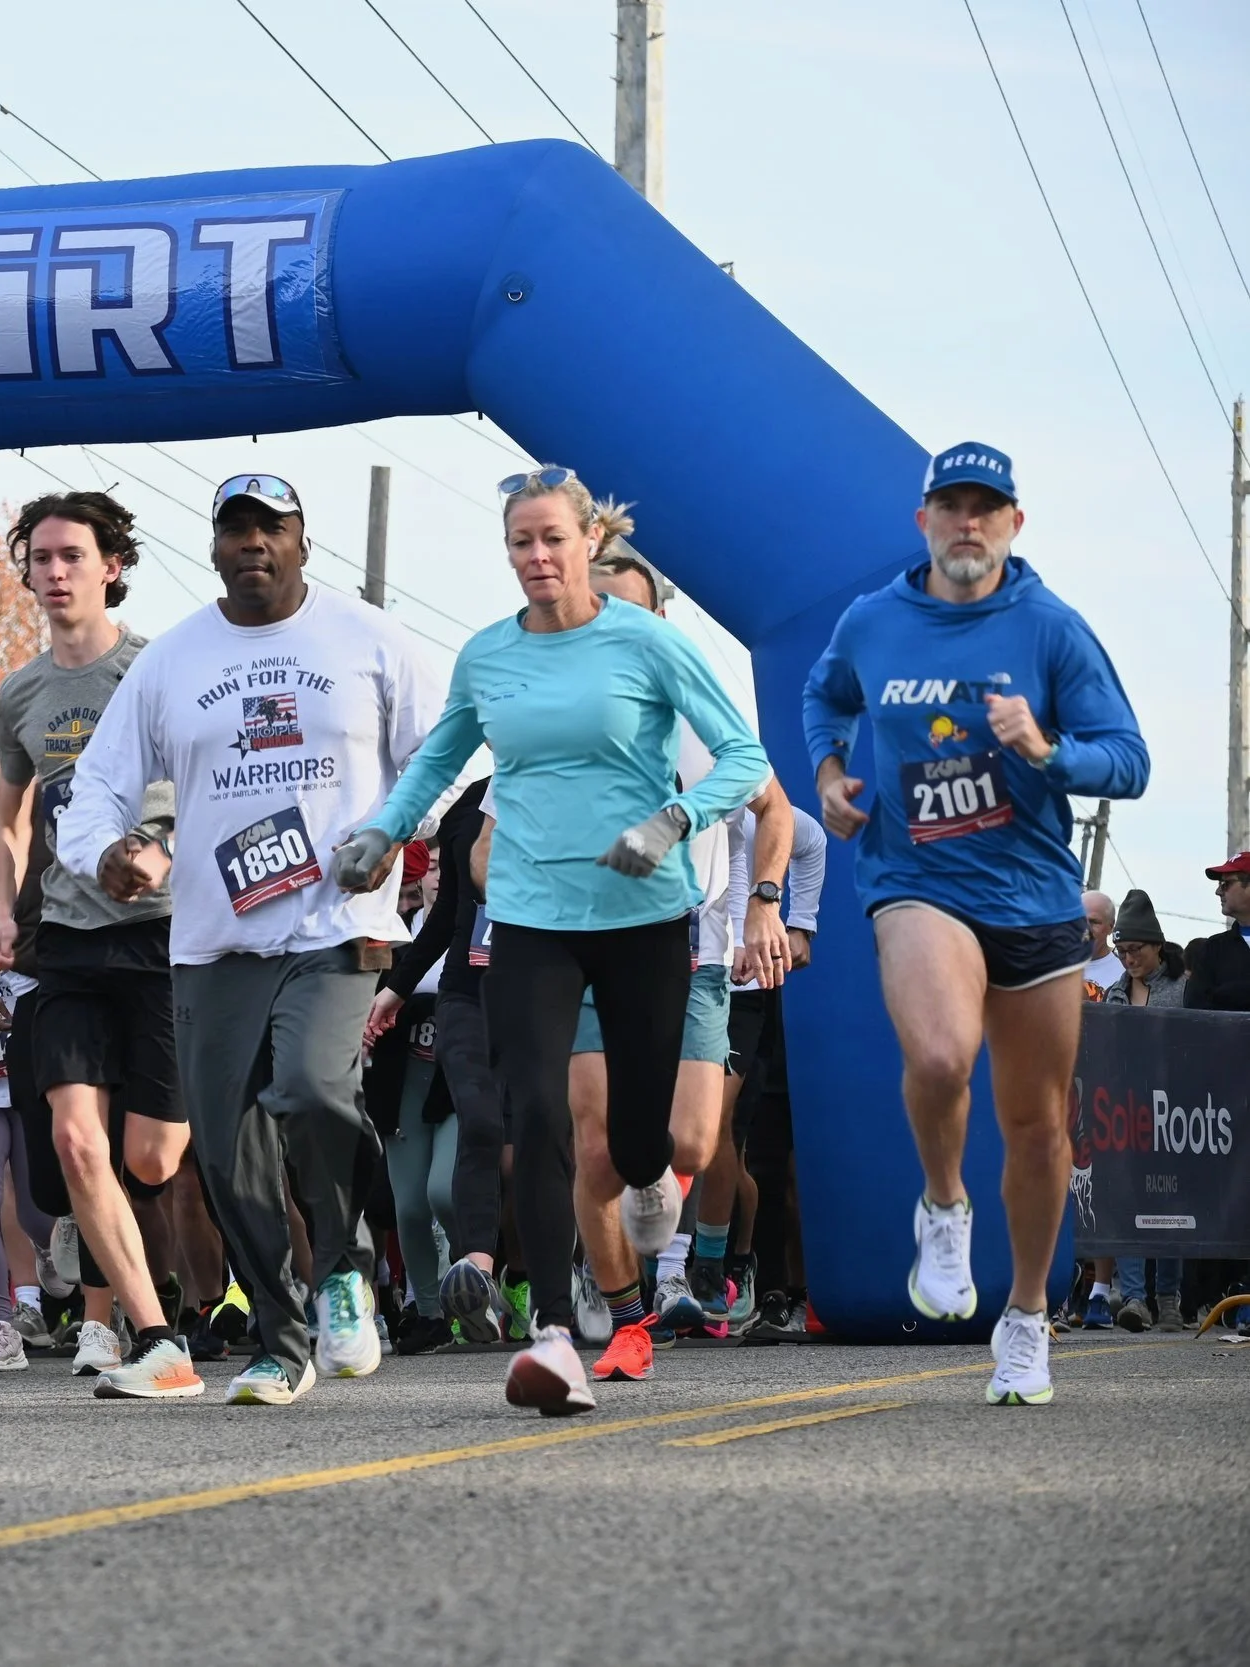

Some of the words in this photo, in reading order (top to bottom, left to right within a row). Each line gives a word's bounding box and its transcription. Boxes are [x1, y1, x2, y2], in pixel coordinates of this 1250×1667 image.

[942, 453, 1004, 475] MERAKI
[222, 664, 243, 677] 3RD
[251, 656, 300, 671] ANNUAL
[197, 678, 241, 710] RUN
[247, 670, 287, 688] FOR
[296, 670, 336, 695] THE
[245, 723, 299, 738] HOPE
[45, 739, 71, 752] TRACK
[213, 757, 334, 790] WARRIORS
[913, 772, 997, 822] 2101
[227, 828, 308, 891] 1850
[409, 1022, 437, 1047] 18
[1146, 1174, 1178, 1193] RACING
